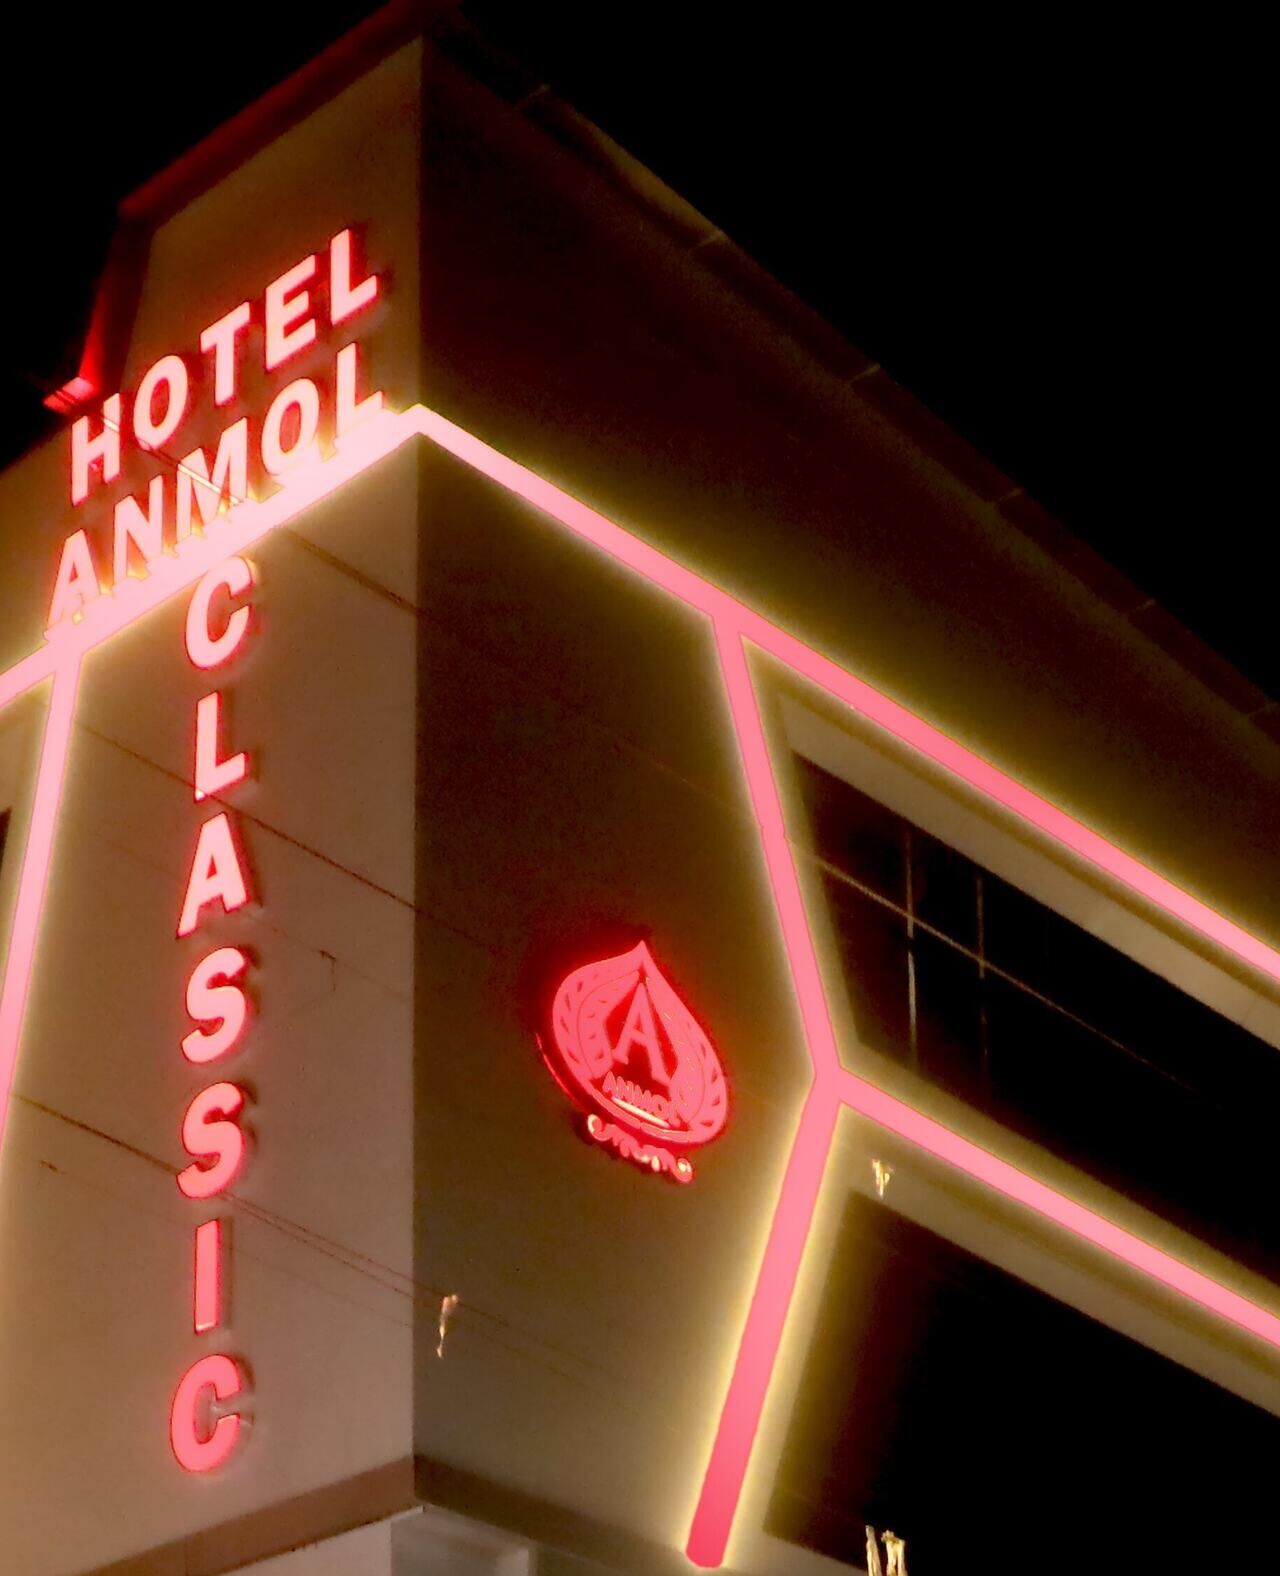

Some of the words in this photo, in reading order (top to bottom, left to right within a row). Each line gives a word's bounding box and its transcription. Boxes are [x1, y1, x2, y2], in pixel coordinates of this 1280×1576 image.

[45, 342, 385, 635] ANMOL
[71, 228, 378, 507] HOTEL
[170, 555, 253, 1474] CLASSIC
